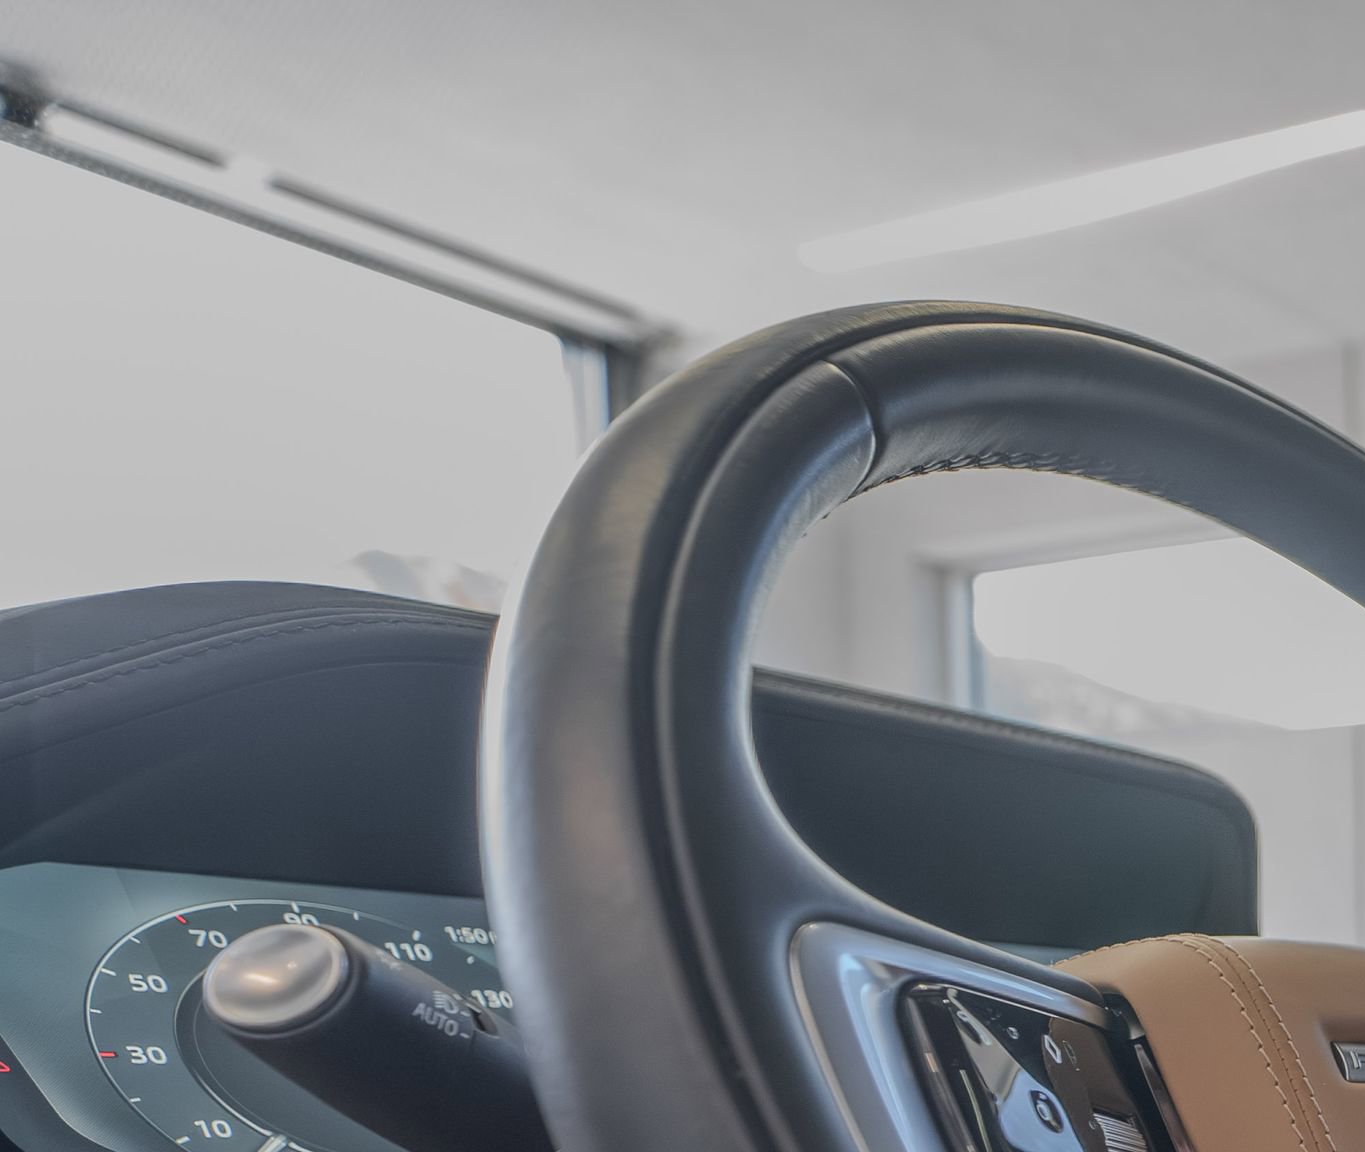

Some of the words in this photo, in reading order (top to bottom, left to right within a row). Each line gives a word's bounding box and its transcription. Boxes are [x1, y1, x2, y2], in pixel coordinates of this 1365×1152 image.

[188, 928, 228, 948] 70
[384, 941, 434, 962] 110
[128, 973, 169, 993] 50
[471, 989, 513, 1009] 130
[411, 1002, 459, 1037] AUTO
[125, 1046, 168, 1065] 30
[193, 1119, 233, 1139] 10
